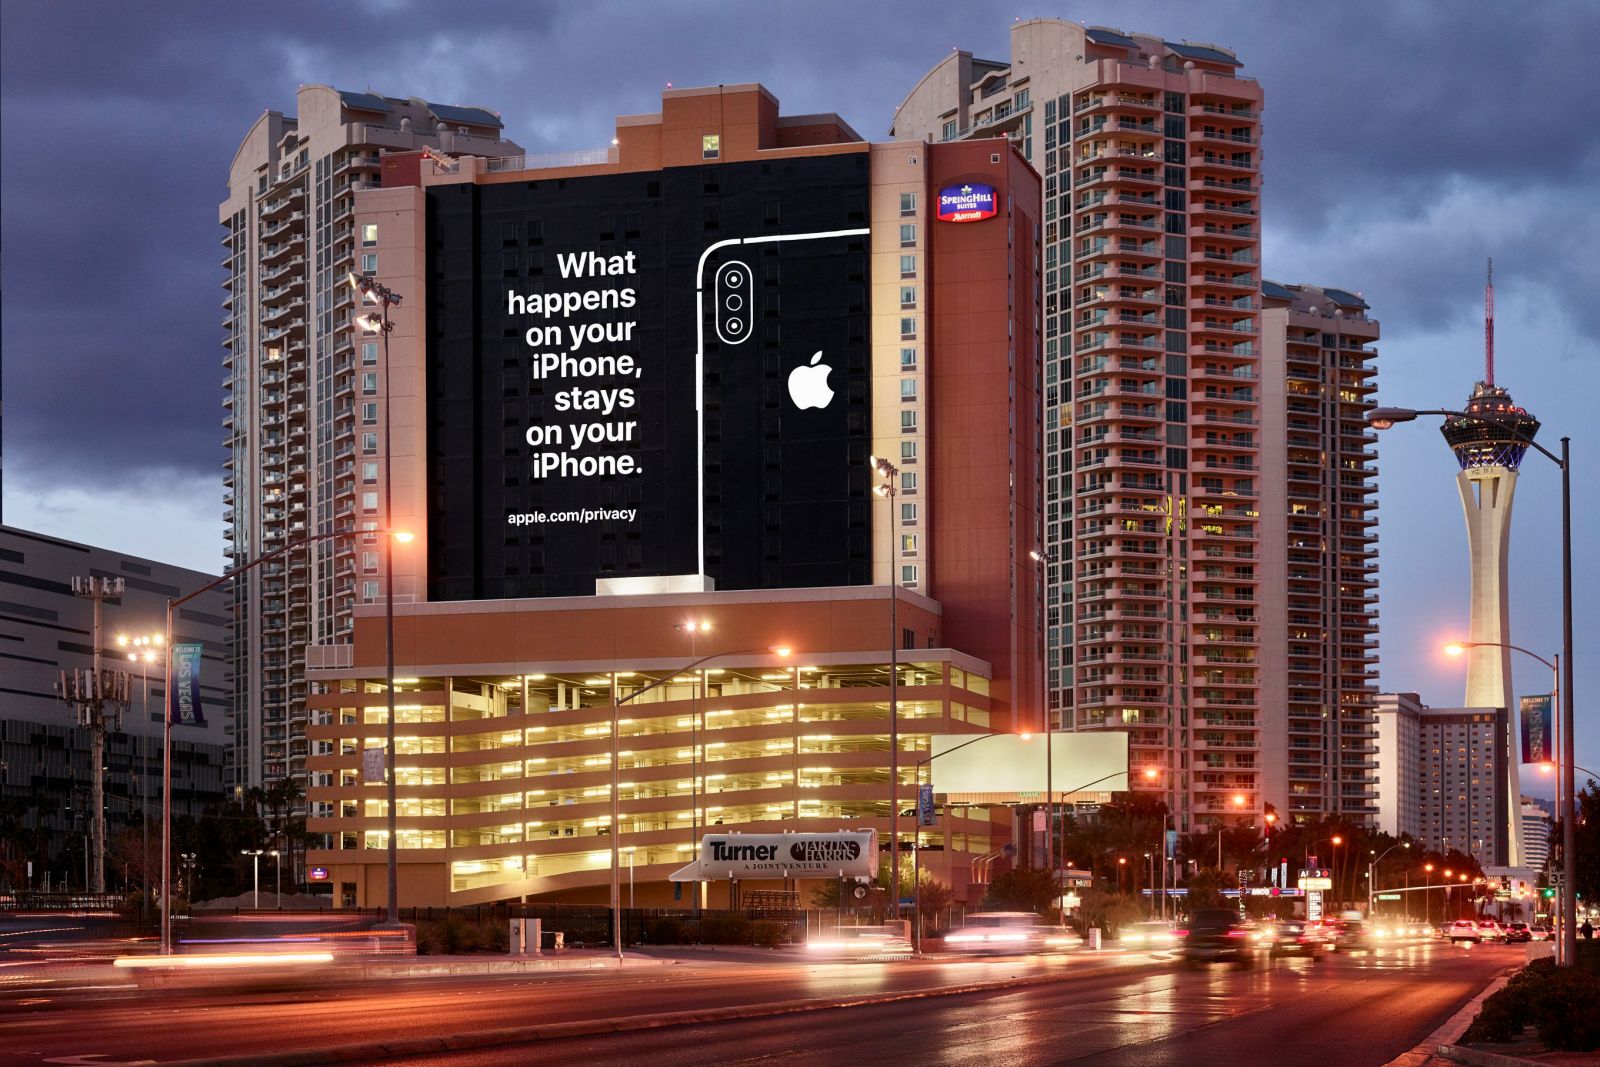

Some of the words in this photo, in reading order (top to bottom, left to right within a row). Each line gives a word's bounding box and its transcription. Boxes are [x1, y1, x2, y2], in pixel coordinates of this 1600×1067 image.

[941, 193, 992, 205] SPRINGHILL
[956, 202, 977, 210] SUITES
[952, 210, 982, 222] Marriott
[557, 251, 636, 278] What
[508, 288, 636, 318] happens
[526, 326, 562, 346] on
[569, 322, 636, 351] your
[533, 353, 642, 379] iPhone,
[555, 387, 635, 415] stays
[526, 425, 562, 446] on
[570, 421, 636, 450] your
[533, 452, 643, 479] iPhone.
[508, 507, 637, 526] apple.com/privacy
[178, 654, 193, 678] LAS
[178, 680, 195, 720] VEGAS
[709, 841, 778, 861] Turner
[804, 850, 856, 861] HARRIS
[782, 862, 829, 870] VENTURE
